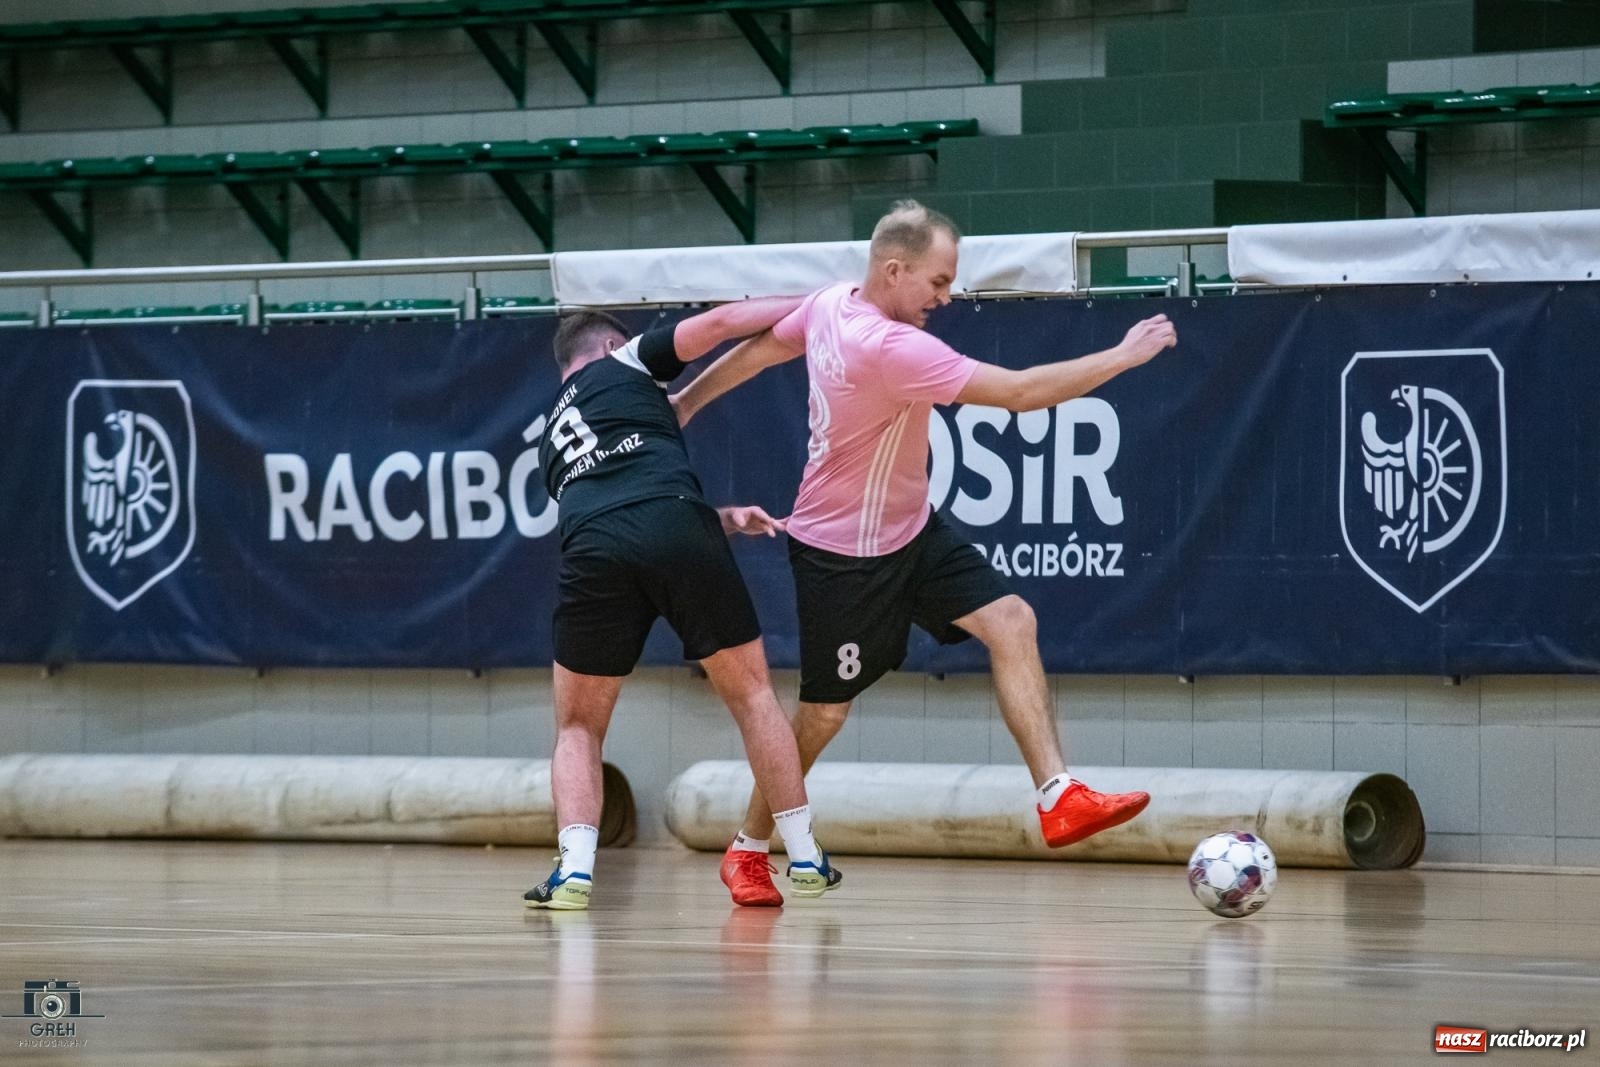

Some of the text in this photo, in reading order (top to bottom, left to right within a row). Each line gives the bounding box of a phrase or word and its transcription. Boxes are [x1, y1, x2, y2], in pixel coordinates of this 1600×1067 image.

[545, 383, 578, 430] ONEK
[550, 406, 599, 464] 9
[837, 642, 862, 680] 8
